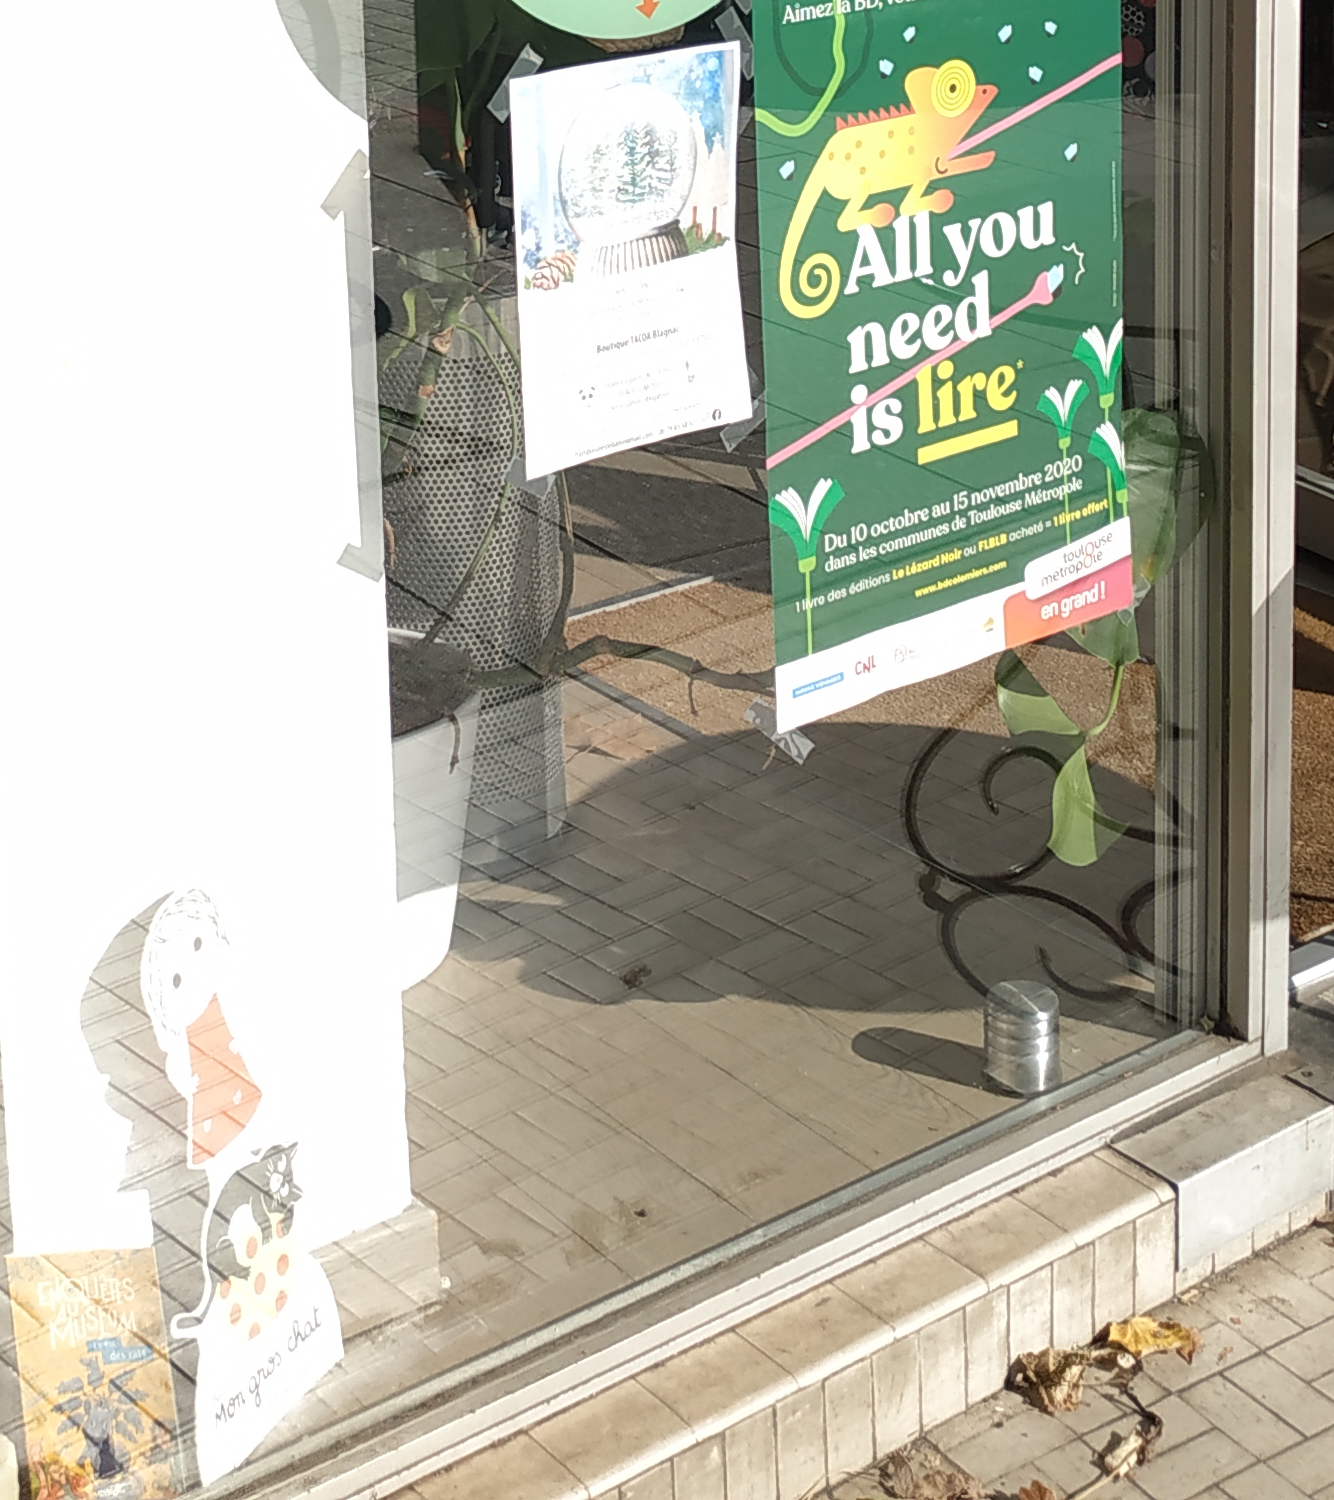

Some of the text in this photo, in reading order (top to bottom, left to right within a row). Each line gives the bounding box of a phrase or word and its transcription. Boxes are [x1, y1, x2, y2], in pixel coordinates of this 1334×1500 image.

[782, 1, 833, 25] Aimez
[844, 210, 933, 295] All
[943, 200, 1055, 287] you
[597, 339, 629, 354] Boutique
[847, 269, 992, 374] need
[850, 384, 903, 454] is
[824, 454, 1082, 553] Du 10 octobre au 15 novembre 2020
[824, 477, 1083, 573] dans les communes de Toulouse Métropole
[827, 509, 1078, 604] des Le ou livre
[1040, 582, 1098, 619] en grand
[215, 1306, 321, 1429] Mon gros chat
